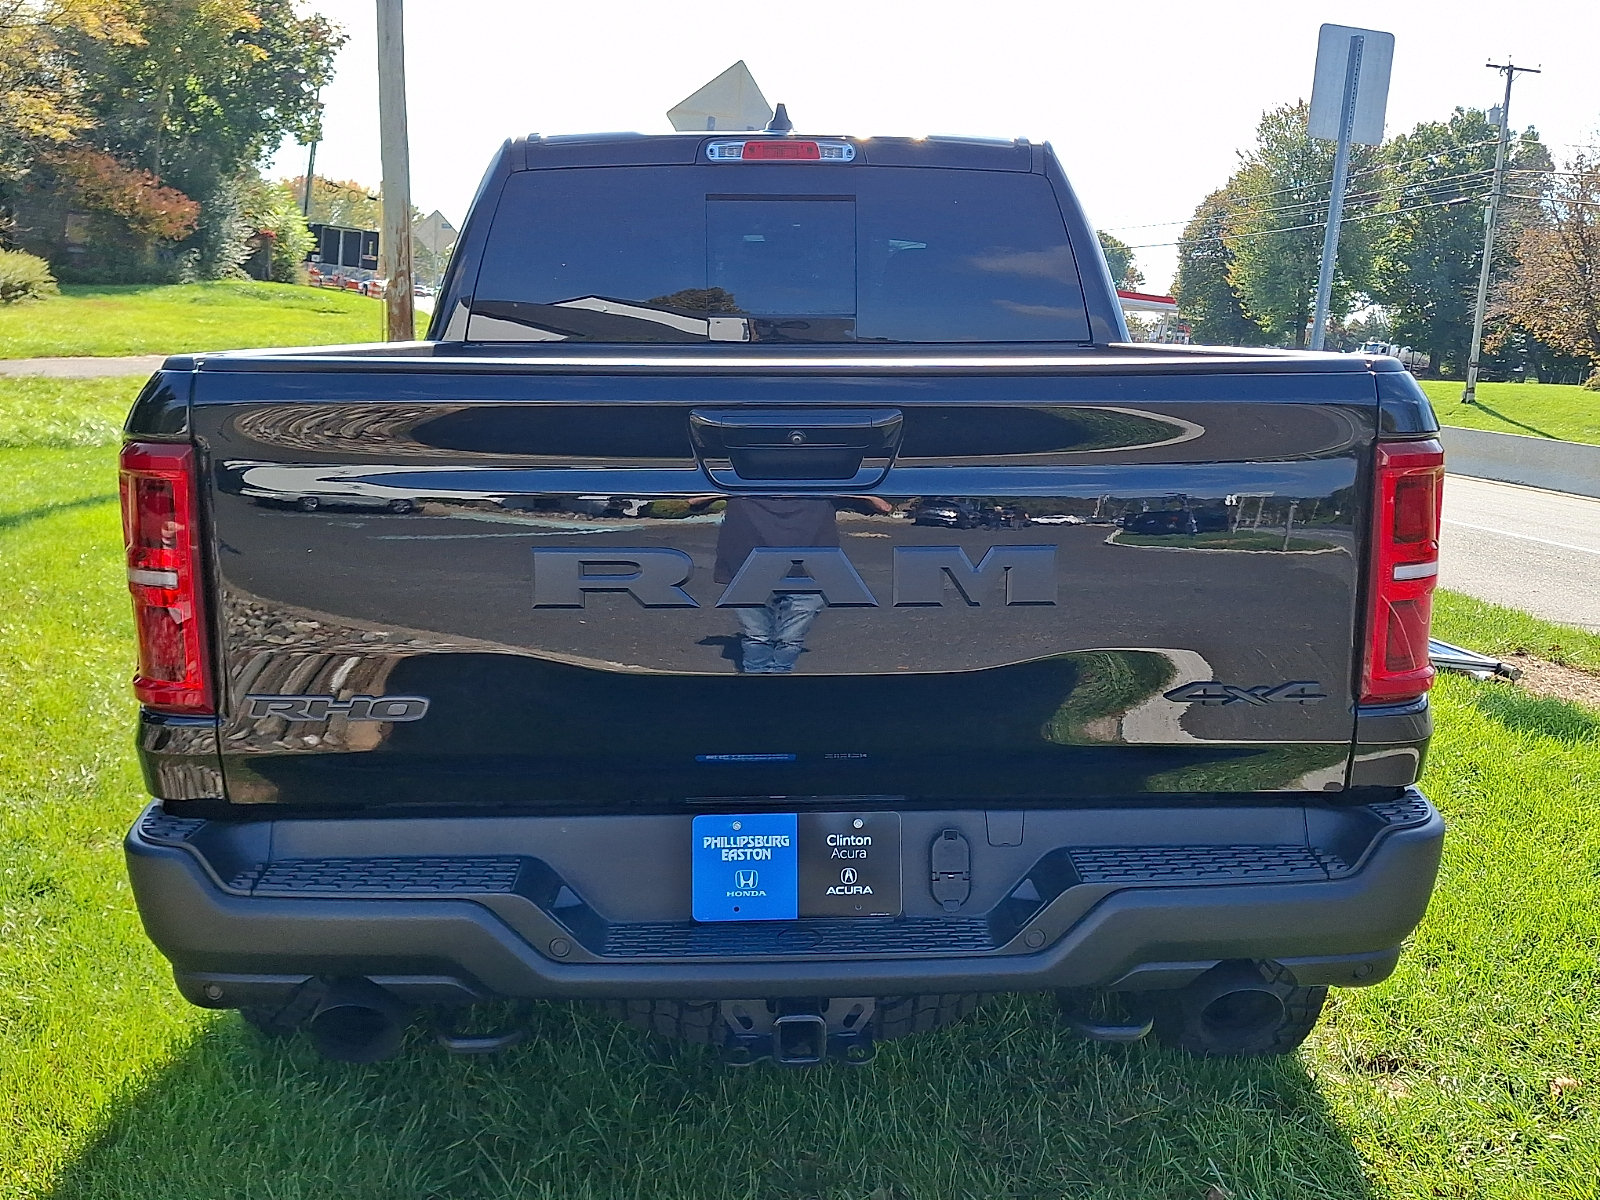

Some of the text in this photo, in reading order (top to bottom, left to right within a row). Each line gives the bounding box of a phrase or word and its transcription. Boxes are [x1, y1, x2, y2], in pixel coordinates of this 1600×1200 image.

[532, 545, 1058, 608] RAM
[245, 694, 430, 721] RHO
[703, 835, 790, 850] PHILLIPSBURG
[826, 834, 872, 846] Clinton
[721, 848, 772, 862] EASTON
[831, 848, 867, 859] Acura
[826, 886, 873, 895] ACURA
